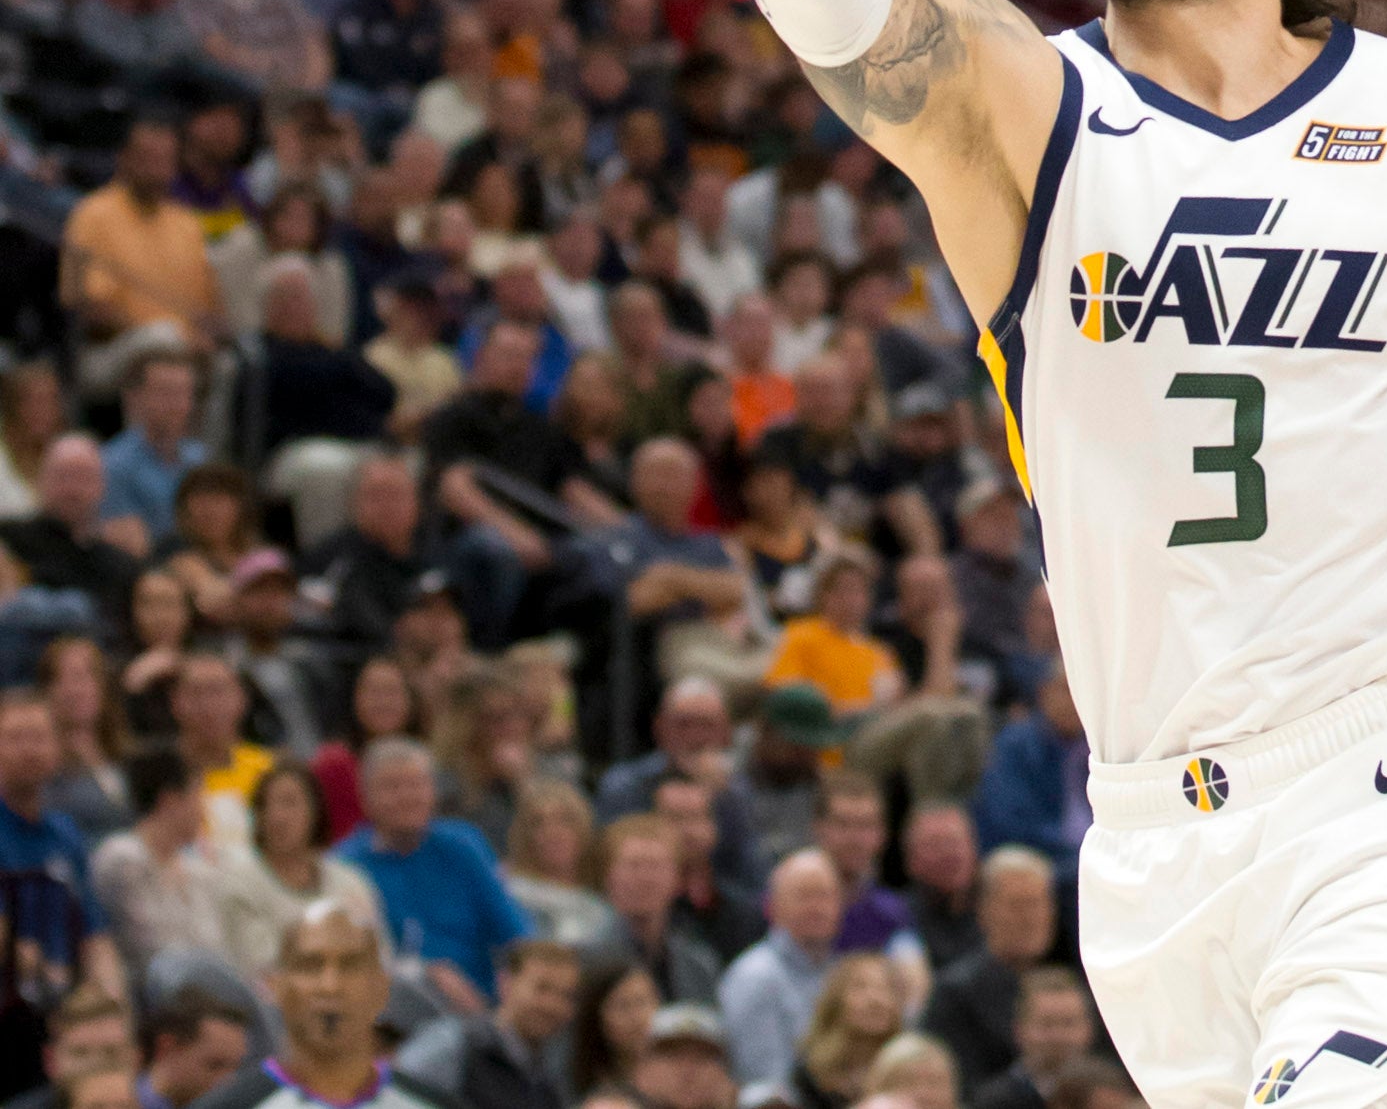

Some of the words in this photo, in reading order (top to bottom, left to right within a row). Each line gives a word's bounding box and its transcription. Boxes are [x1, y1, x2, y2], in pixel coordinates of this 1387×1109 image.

[1301, 126, 1329, 157] 5
[1327, 144, 1381, 160] FIGHT
[1165, 373, 1268, 547] 3
